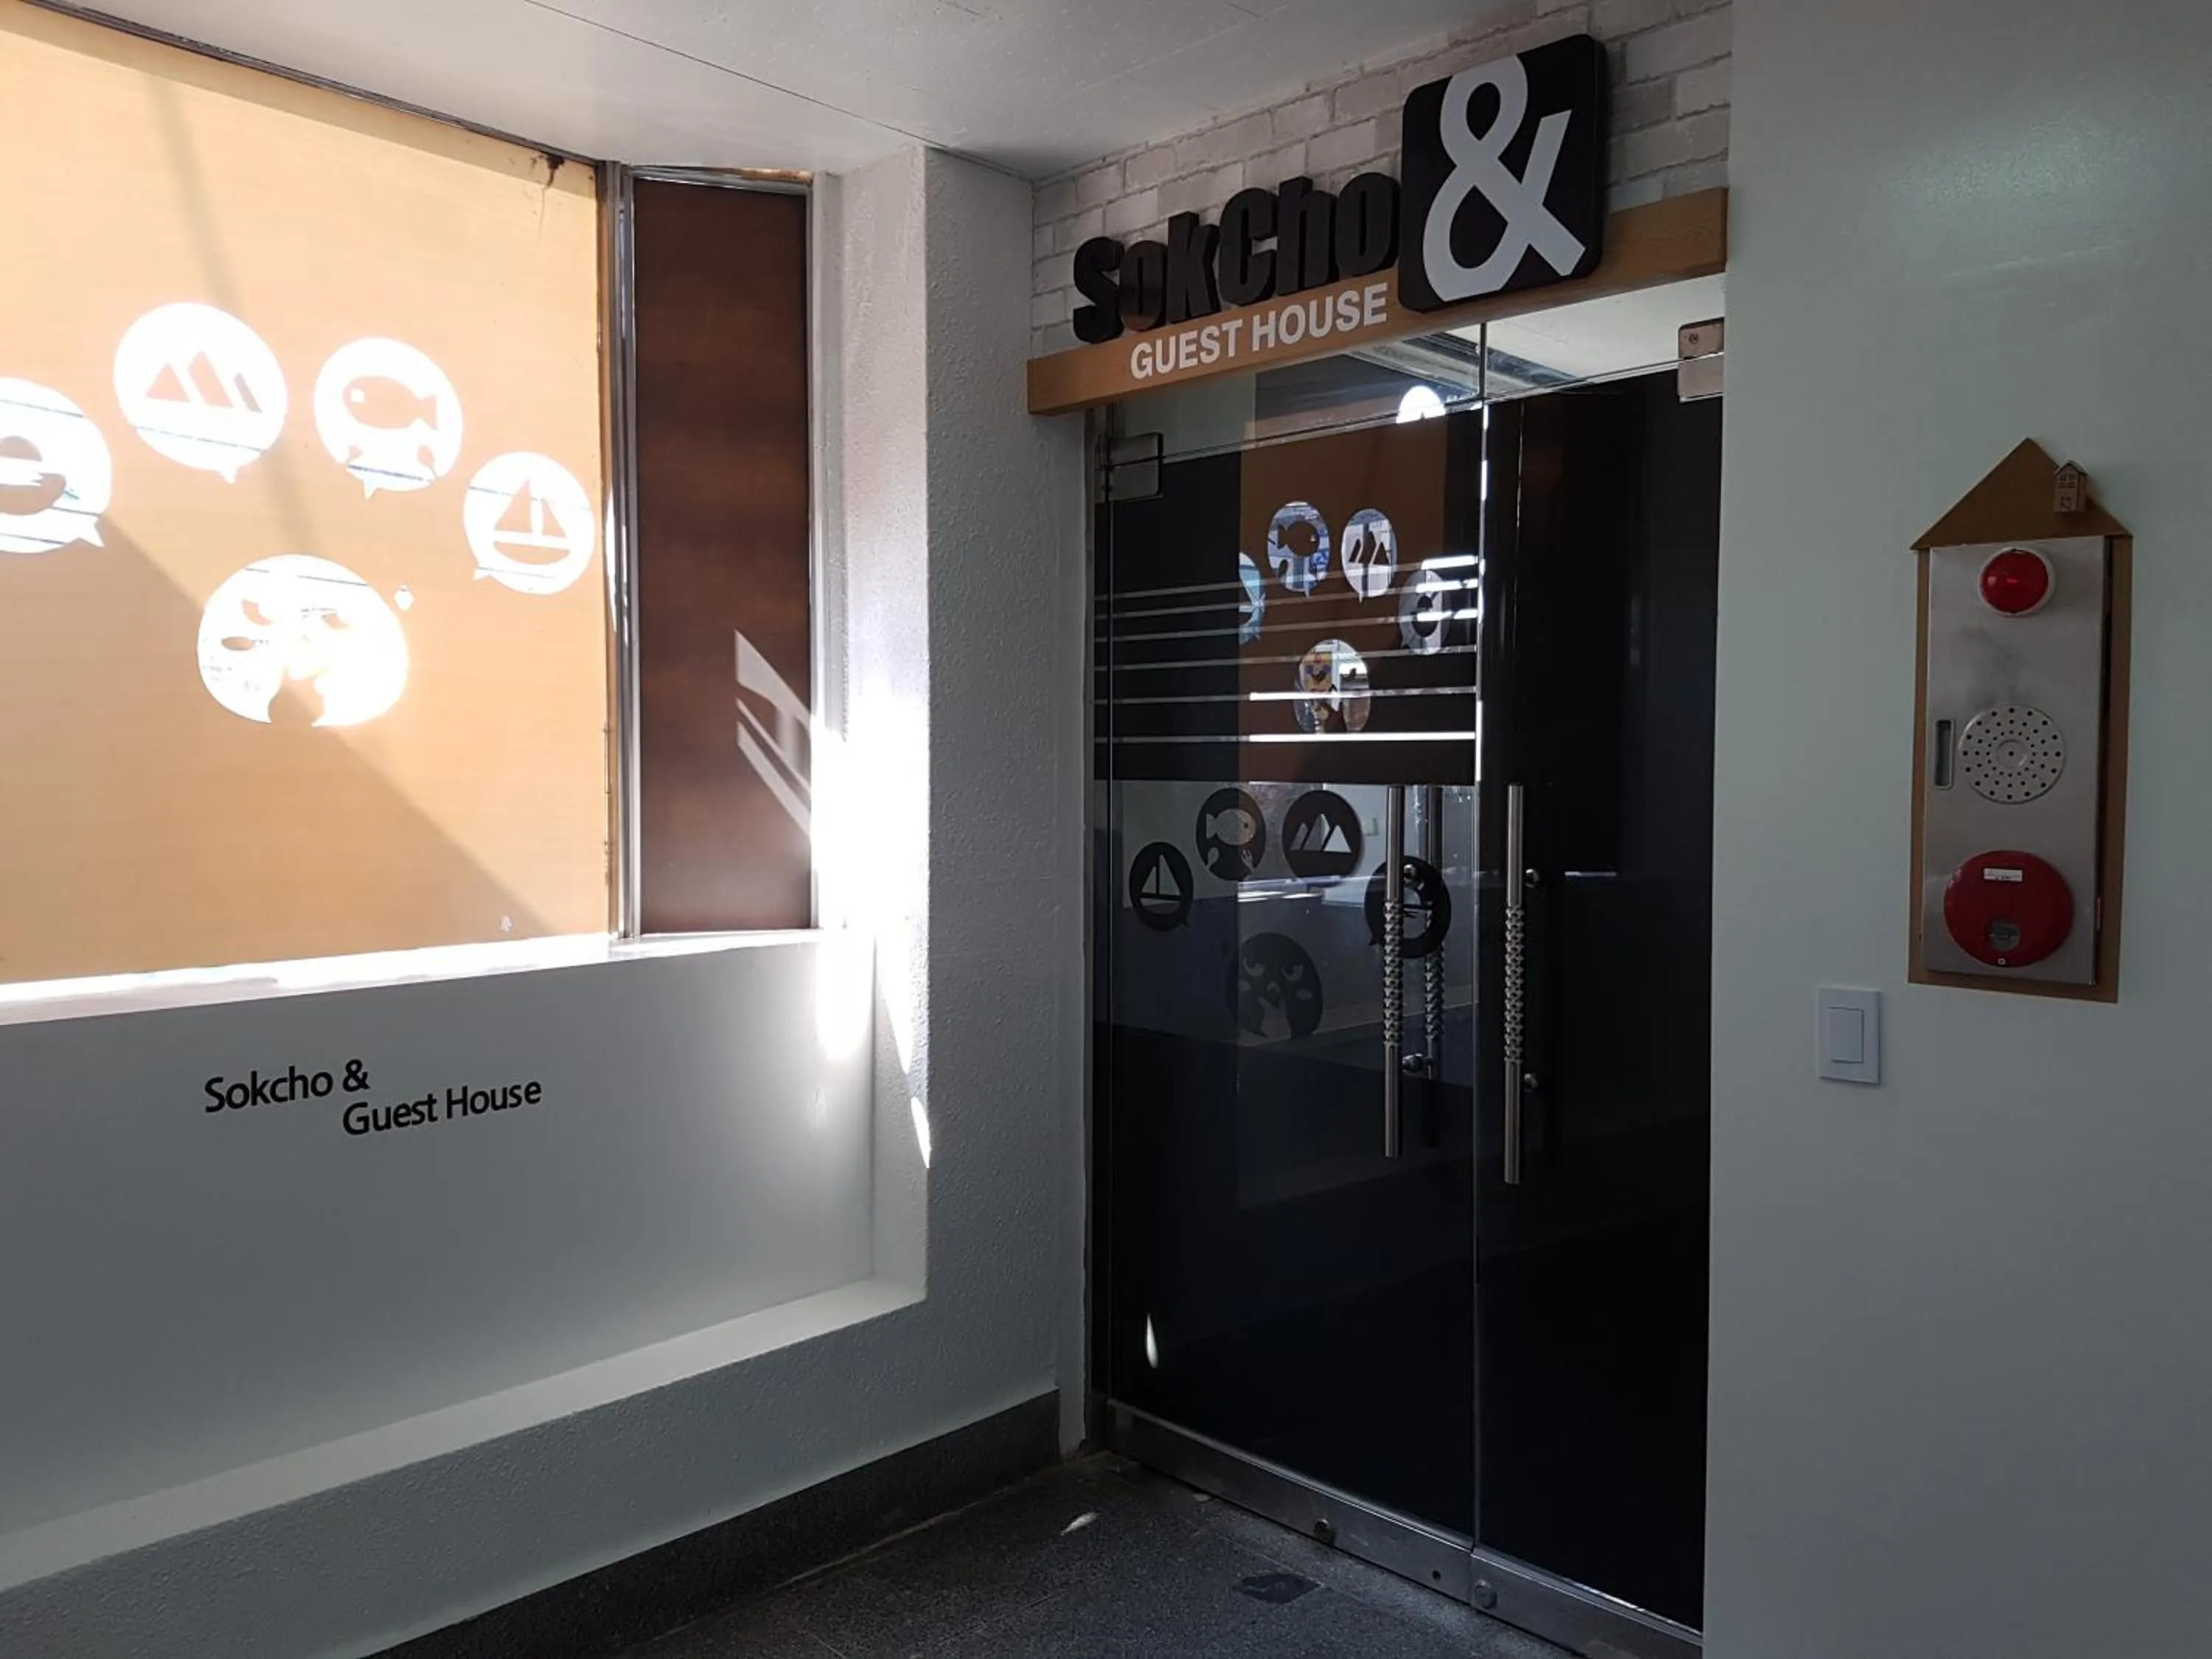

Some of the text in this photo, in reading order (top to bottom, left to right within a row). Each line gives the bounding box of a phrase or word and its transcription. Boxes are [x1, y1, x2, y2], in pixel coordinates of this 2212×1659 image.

[1423, 53, 1586, 302] &
[1130, 282, 1388, 380] GUEST HOUSE
[204, 1059, 371, 1113] Sokcho &
[343, 1080, 542, 1135] Guest House
